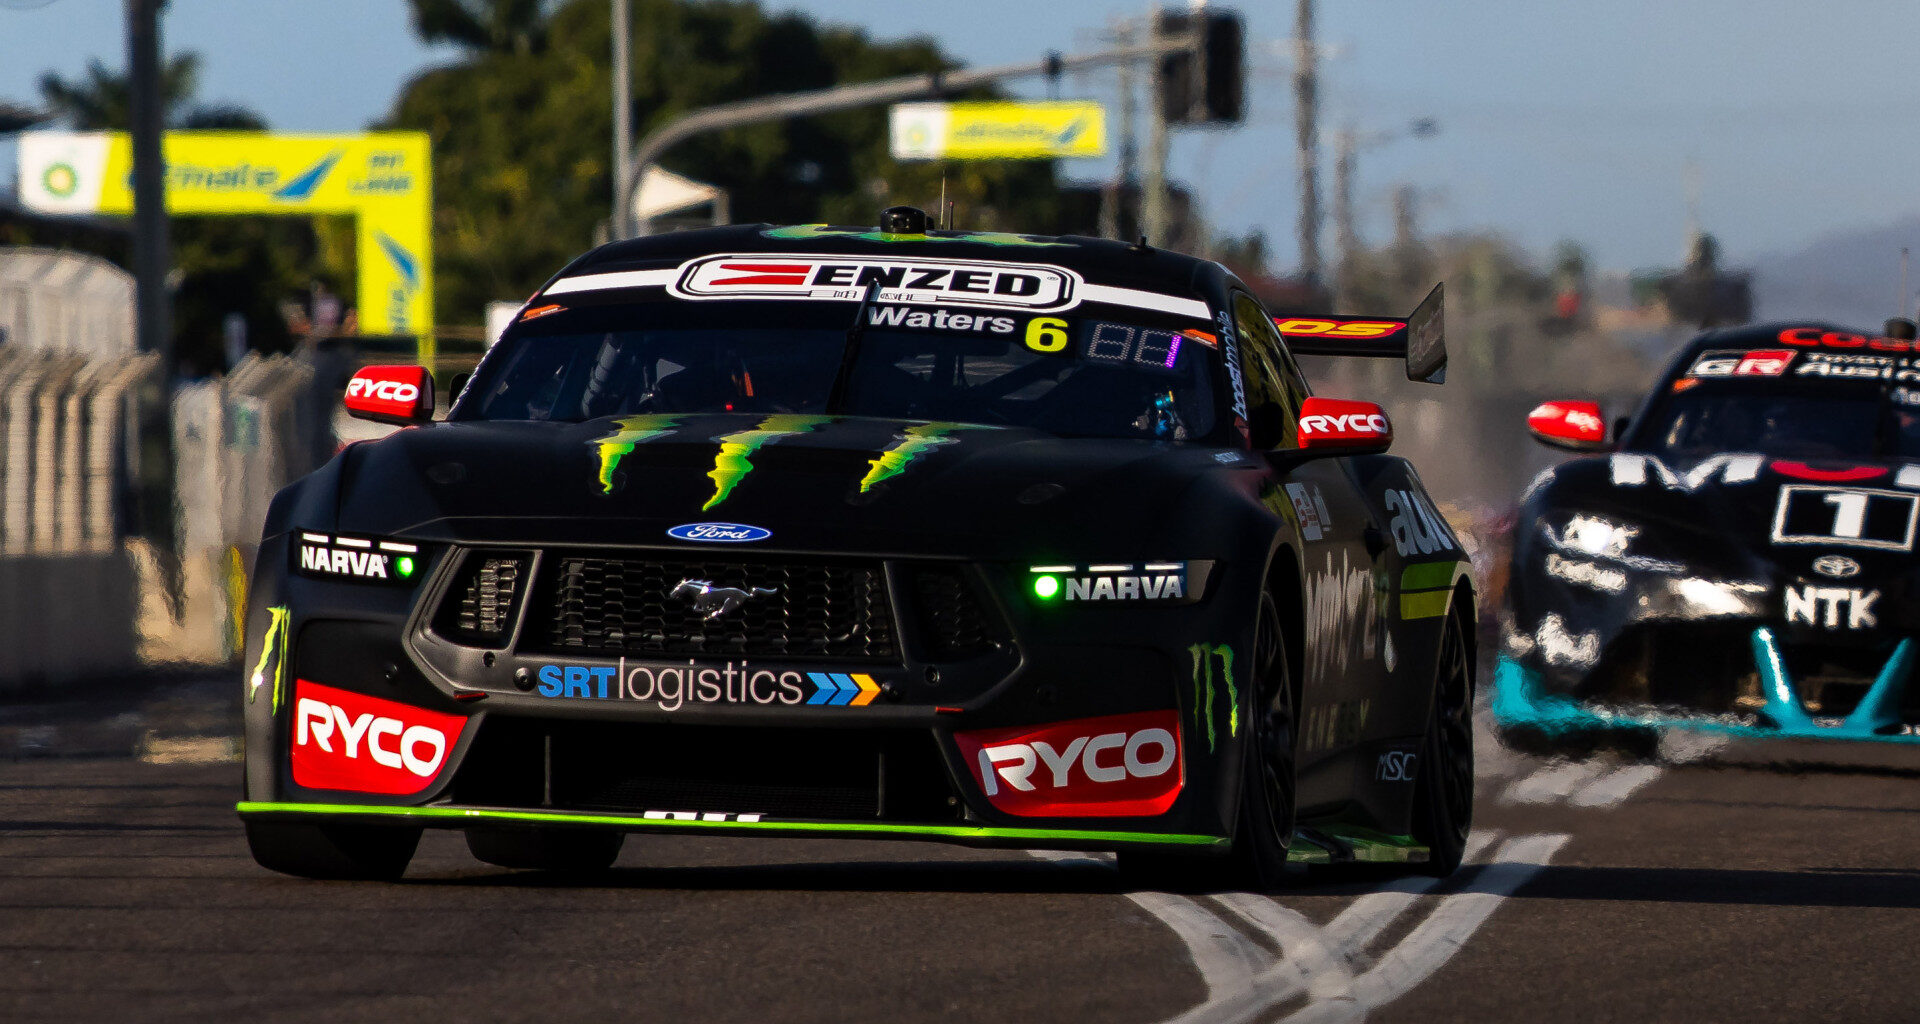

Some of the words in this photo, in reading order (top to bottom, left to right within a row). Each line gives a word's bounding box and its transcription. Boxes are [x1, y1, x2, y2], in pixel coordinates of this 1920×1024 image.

[811, 264, 1041, 297] ENZED
[868, 306, 1015, 333] Waters
[1025, 316, 1068, 352] 6
[345, 378, 419, 402] RYCO
[1299, 414, 1388, 434] RYCO
[1823, 492, 1868, 539] 1
[687, 525, 750, 541] Ford
[301, 545, 388, 579] NARVA
[1065, 575, 1184, 600] NARVA
[1784, 585, 1881, 628] NTK
[297, 697, 446, 777] RYCO
[977, 728, 1176, 796] RYCO
